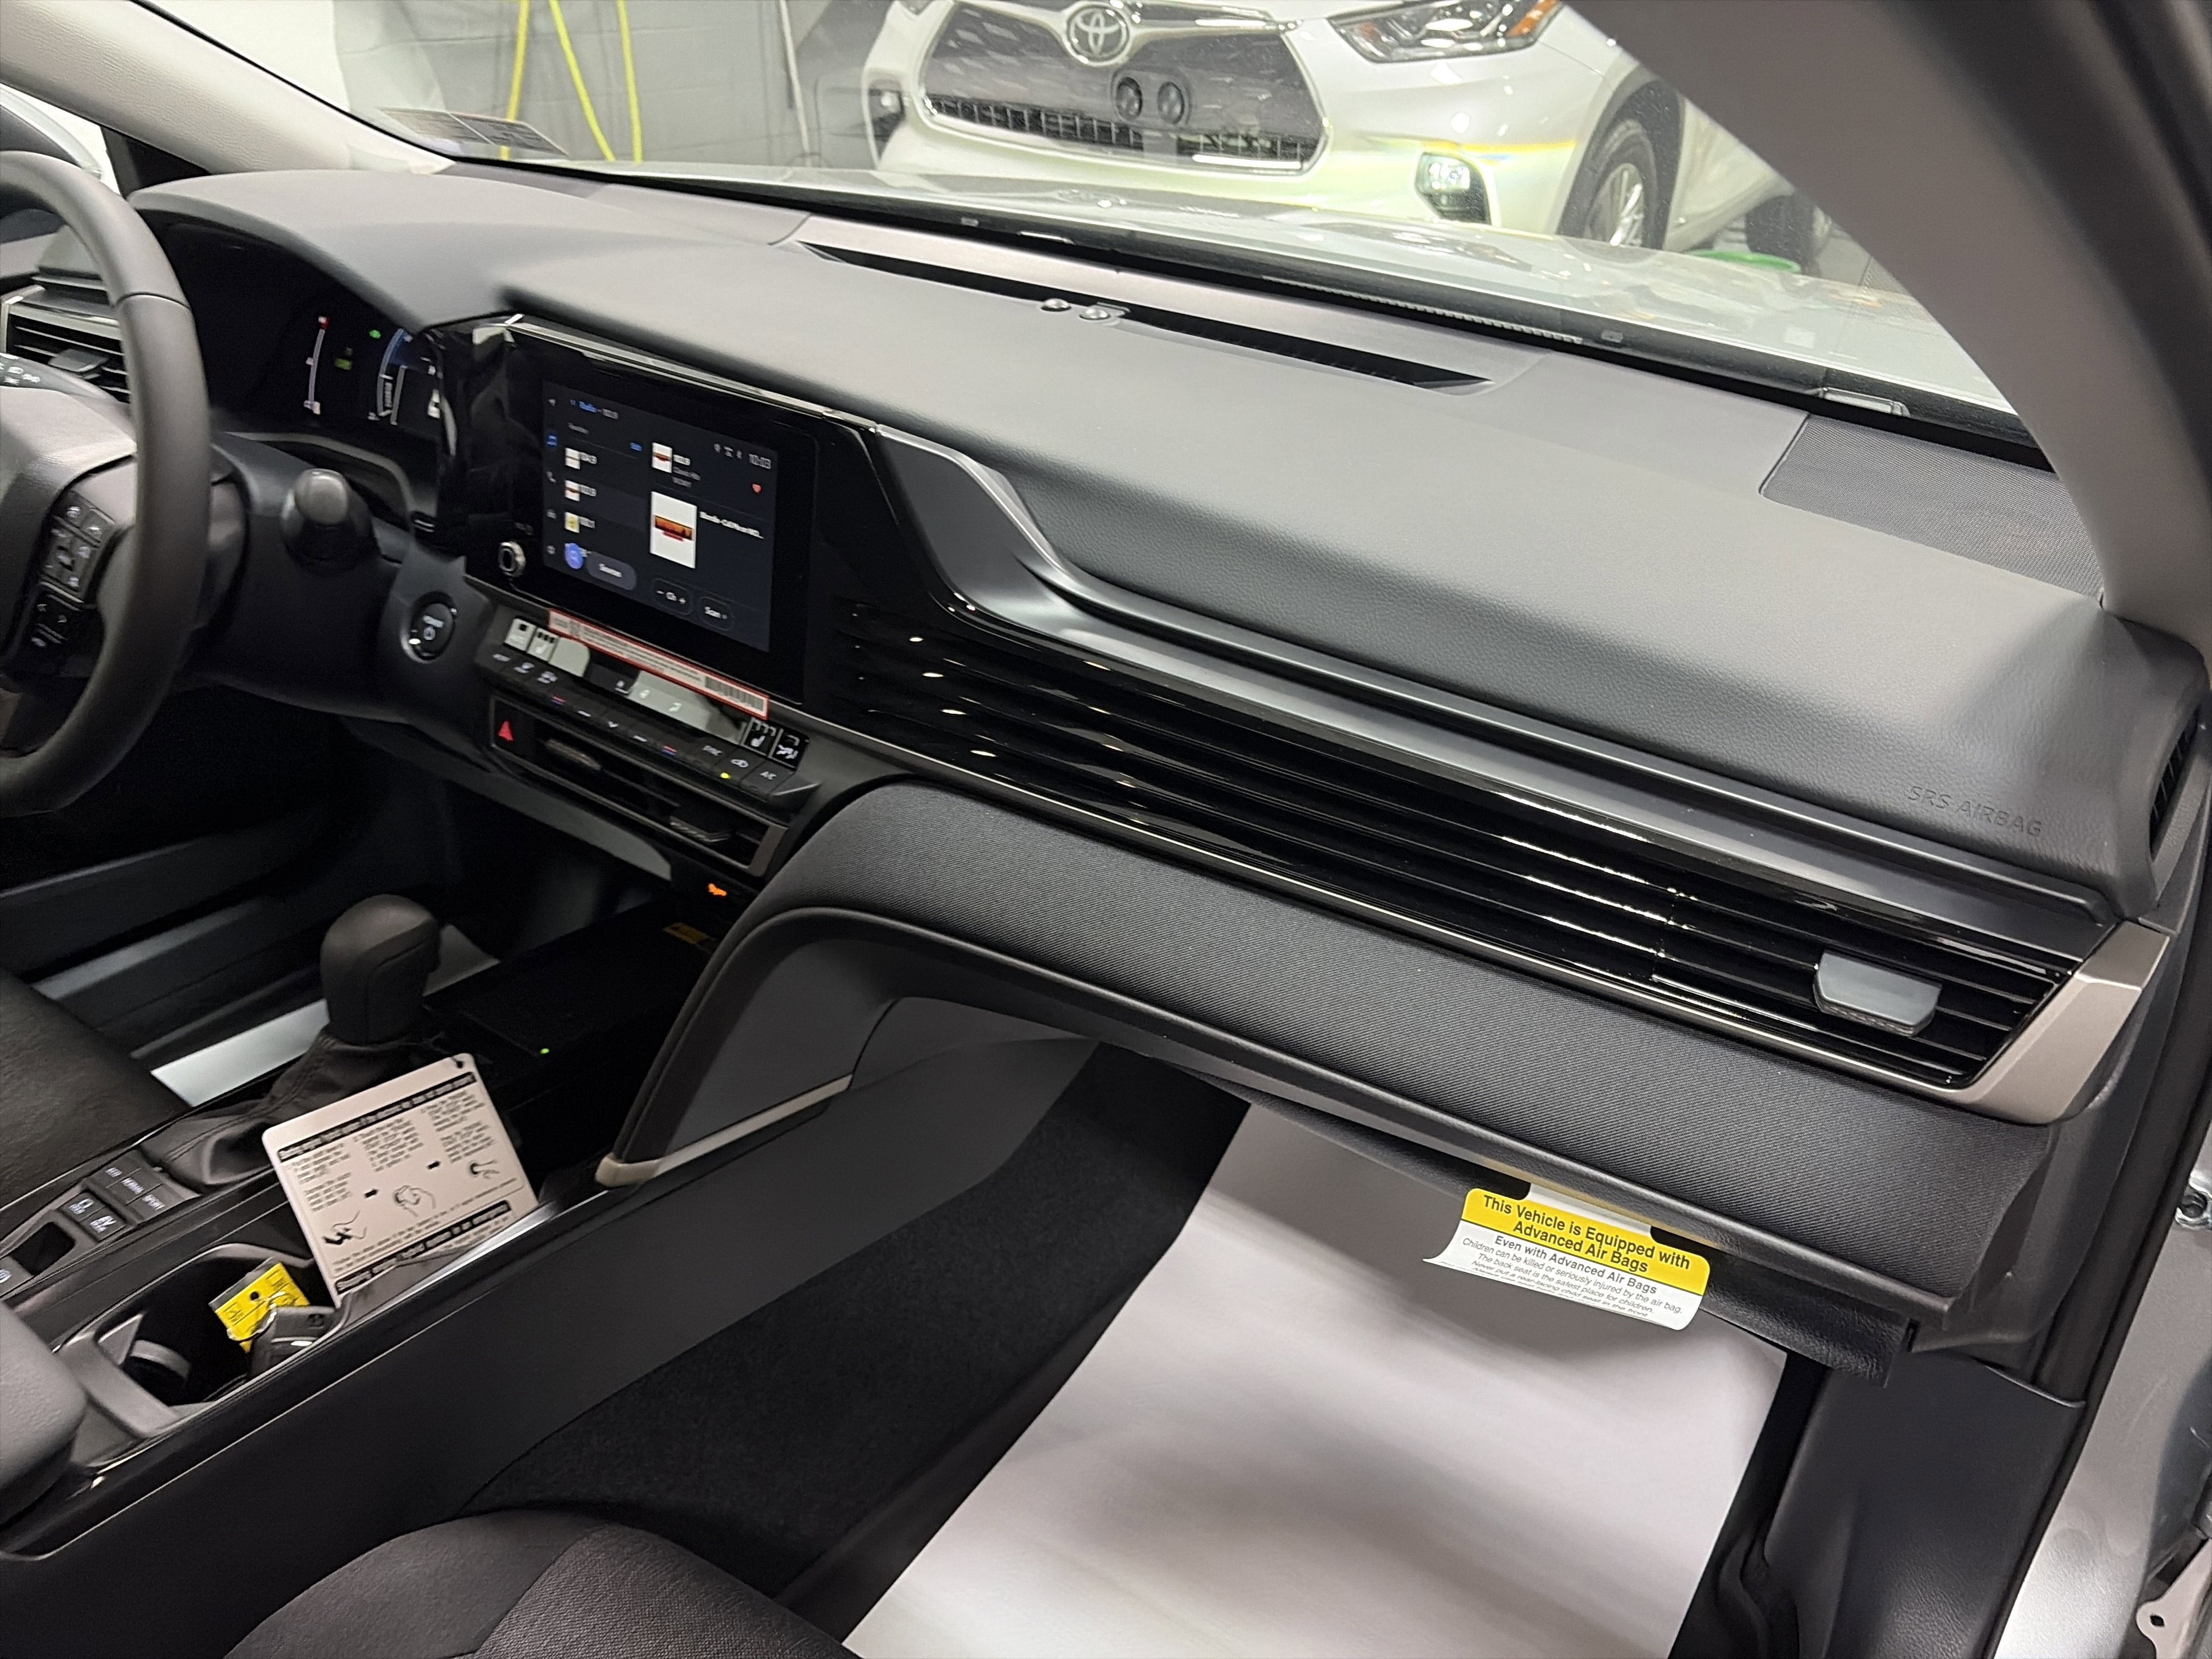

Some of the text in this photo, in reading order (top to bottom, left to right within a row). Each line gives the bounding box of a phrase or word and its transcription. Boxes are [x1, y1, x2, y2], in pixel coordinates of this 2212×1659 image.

[1908, 786, 2042, 836] SRS AIRBAG
[1484, 1194, 1690, 1269] This Vehicle is Equipped with
[1513, 1221, 1648, 1272] Advanced Air Bags
[1463, 1238, 1683, 1313] Children can be killed or seriously injured by the air bag.
[1477, 1253, 1492, 1262] The
[1496, 1257, 1512, 1269] back
[1514, 1266, 1532, 1276] seat
[1541, 1274, 1554, 1282] the
[1555, 1278, 1581, 1290] safest
[1582, 1287, 1604, 1297] place
[1494, 1235, 1657, 1293] Even with Advanced Air Bags
